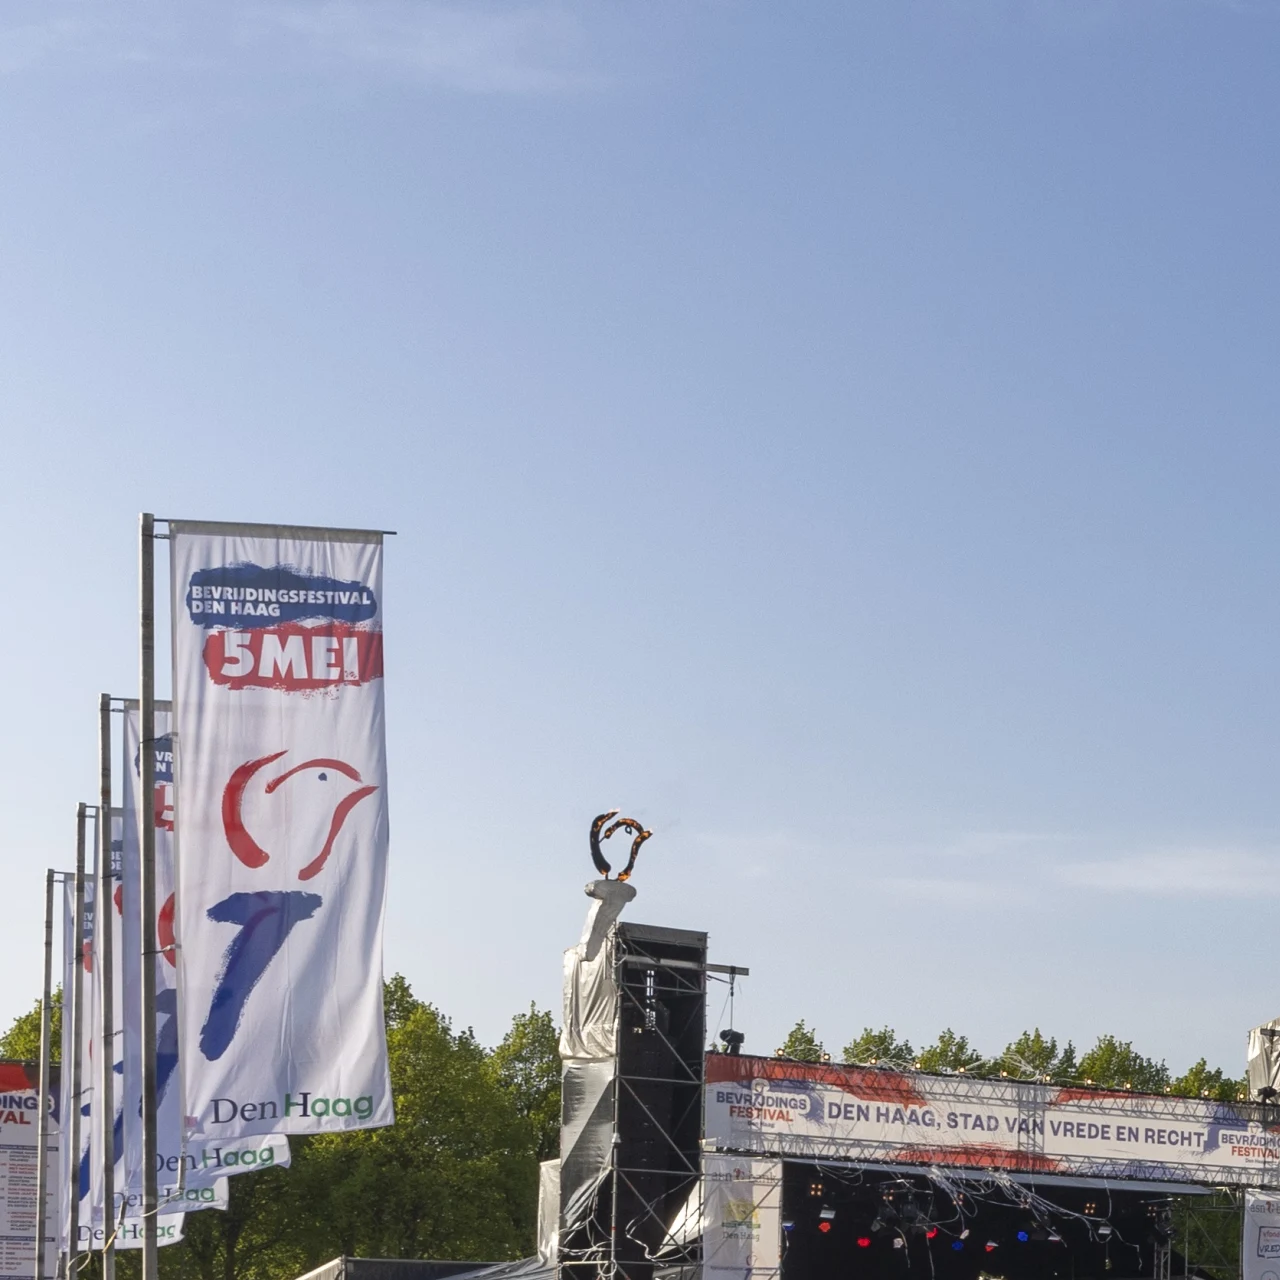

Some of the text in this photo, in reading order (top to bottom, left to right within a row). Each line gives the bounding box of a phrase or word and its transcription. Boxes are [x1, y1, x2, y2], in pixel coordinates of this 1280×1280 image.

[191, 585, 372, 606] BEVRIJDINGSFESTIVAL
[191, 600, 281, 617] DEN HAAG
[210, 1092, 375, 1125] Den Haag
[717, 1090, 808, 1110] BEVRIJDINGS
[729, 1105, 794, 1123] FESTIVAL
[827, 1101, 1204, 1148] DEN HAAG, STAD VAN VREDE EN RECHT
[202, 1145, 275, 1168] Haag
[1231, 1145, 1280, 1160] FESTIVAL
